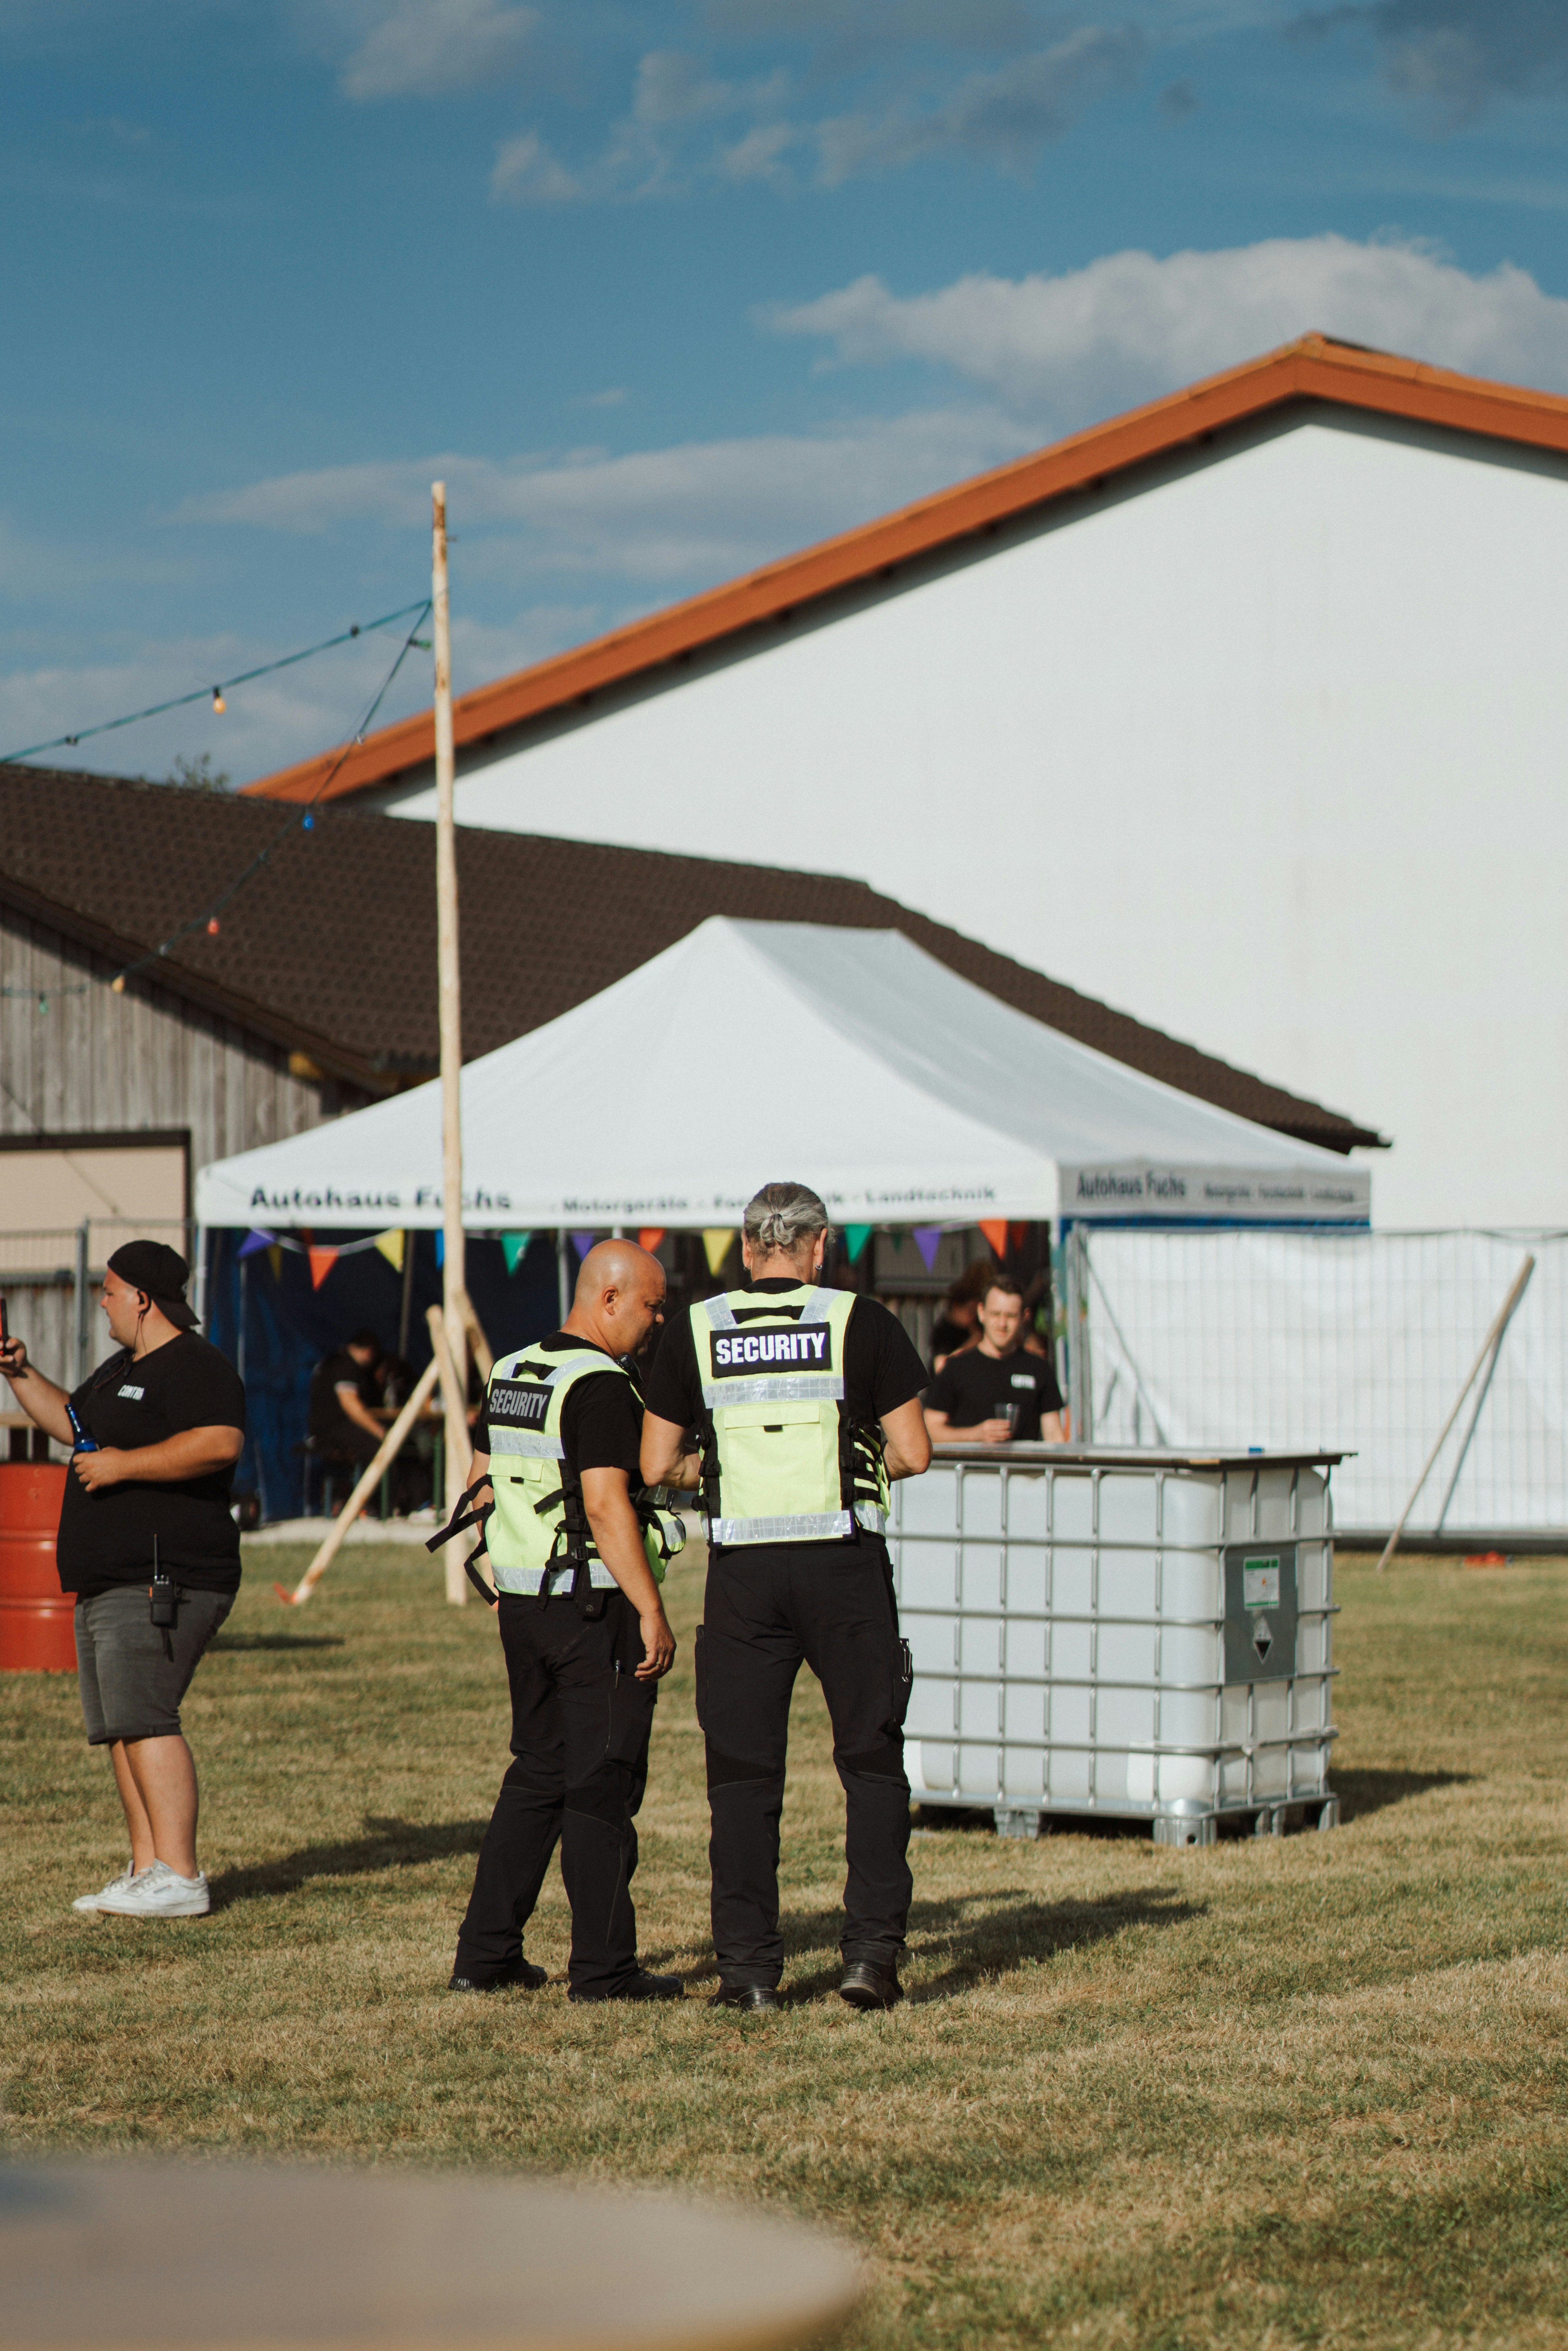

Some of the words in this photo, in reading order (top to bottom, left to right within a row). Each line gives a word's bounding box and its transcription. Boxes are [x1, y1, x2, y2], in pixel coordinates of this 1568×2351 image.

[251, 1185, 400, 1208] Autohaus
[1077, 1170, 1142, 1199] Autohaus
[1146, 1170, 1187, 1199] Fuchs
[716, 1332, 826, 1364] SECURITY
[489, 1388, 548, 1419] SECURITY
